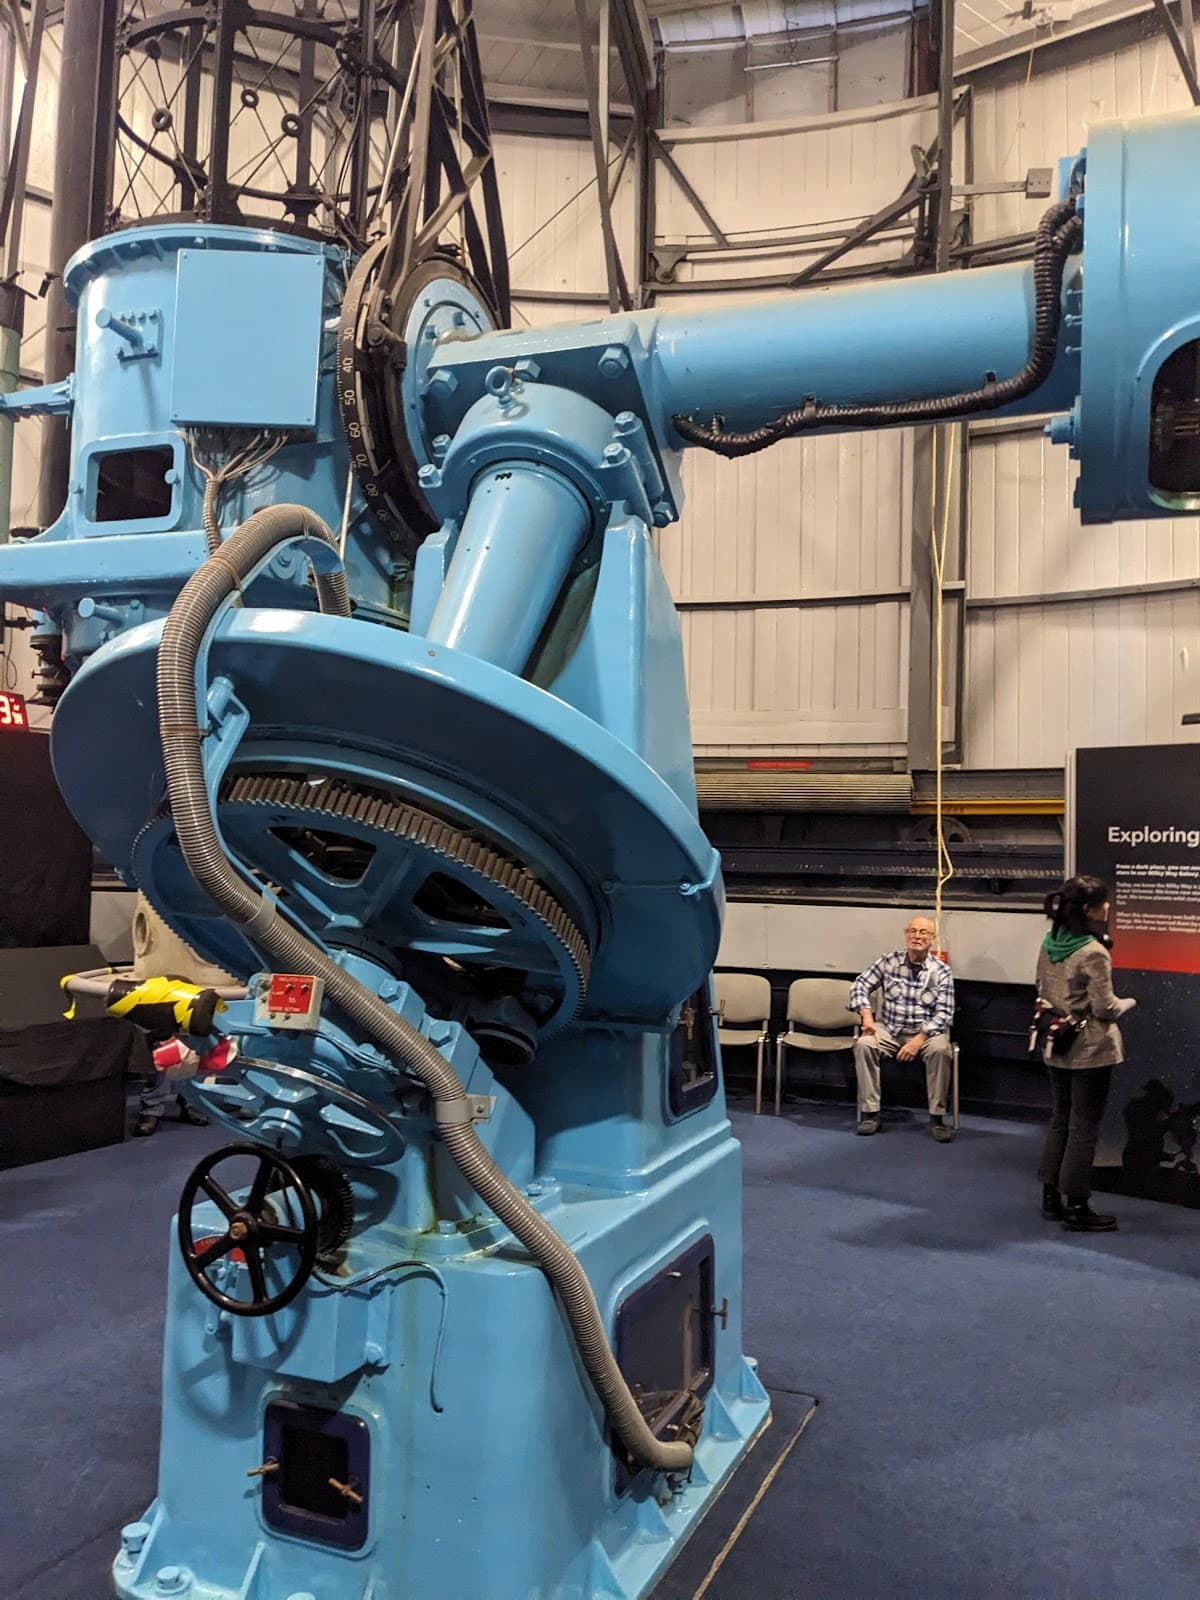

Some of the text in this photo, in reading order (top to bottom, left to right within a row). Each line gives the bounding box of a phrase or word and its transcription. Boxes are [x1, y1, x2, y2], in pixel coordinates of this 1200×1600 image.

[343, 327, 354, 341] 30
[342, 357, 354, 373] 40
[344, 389, 356, 406] 50
[348, 422, 361, 438] 60
[355, 453, 369, 469] 70
[365, 483, 379, 497] 80
[1108, 825, 1200, 848] Exploring
